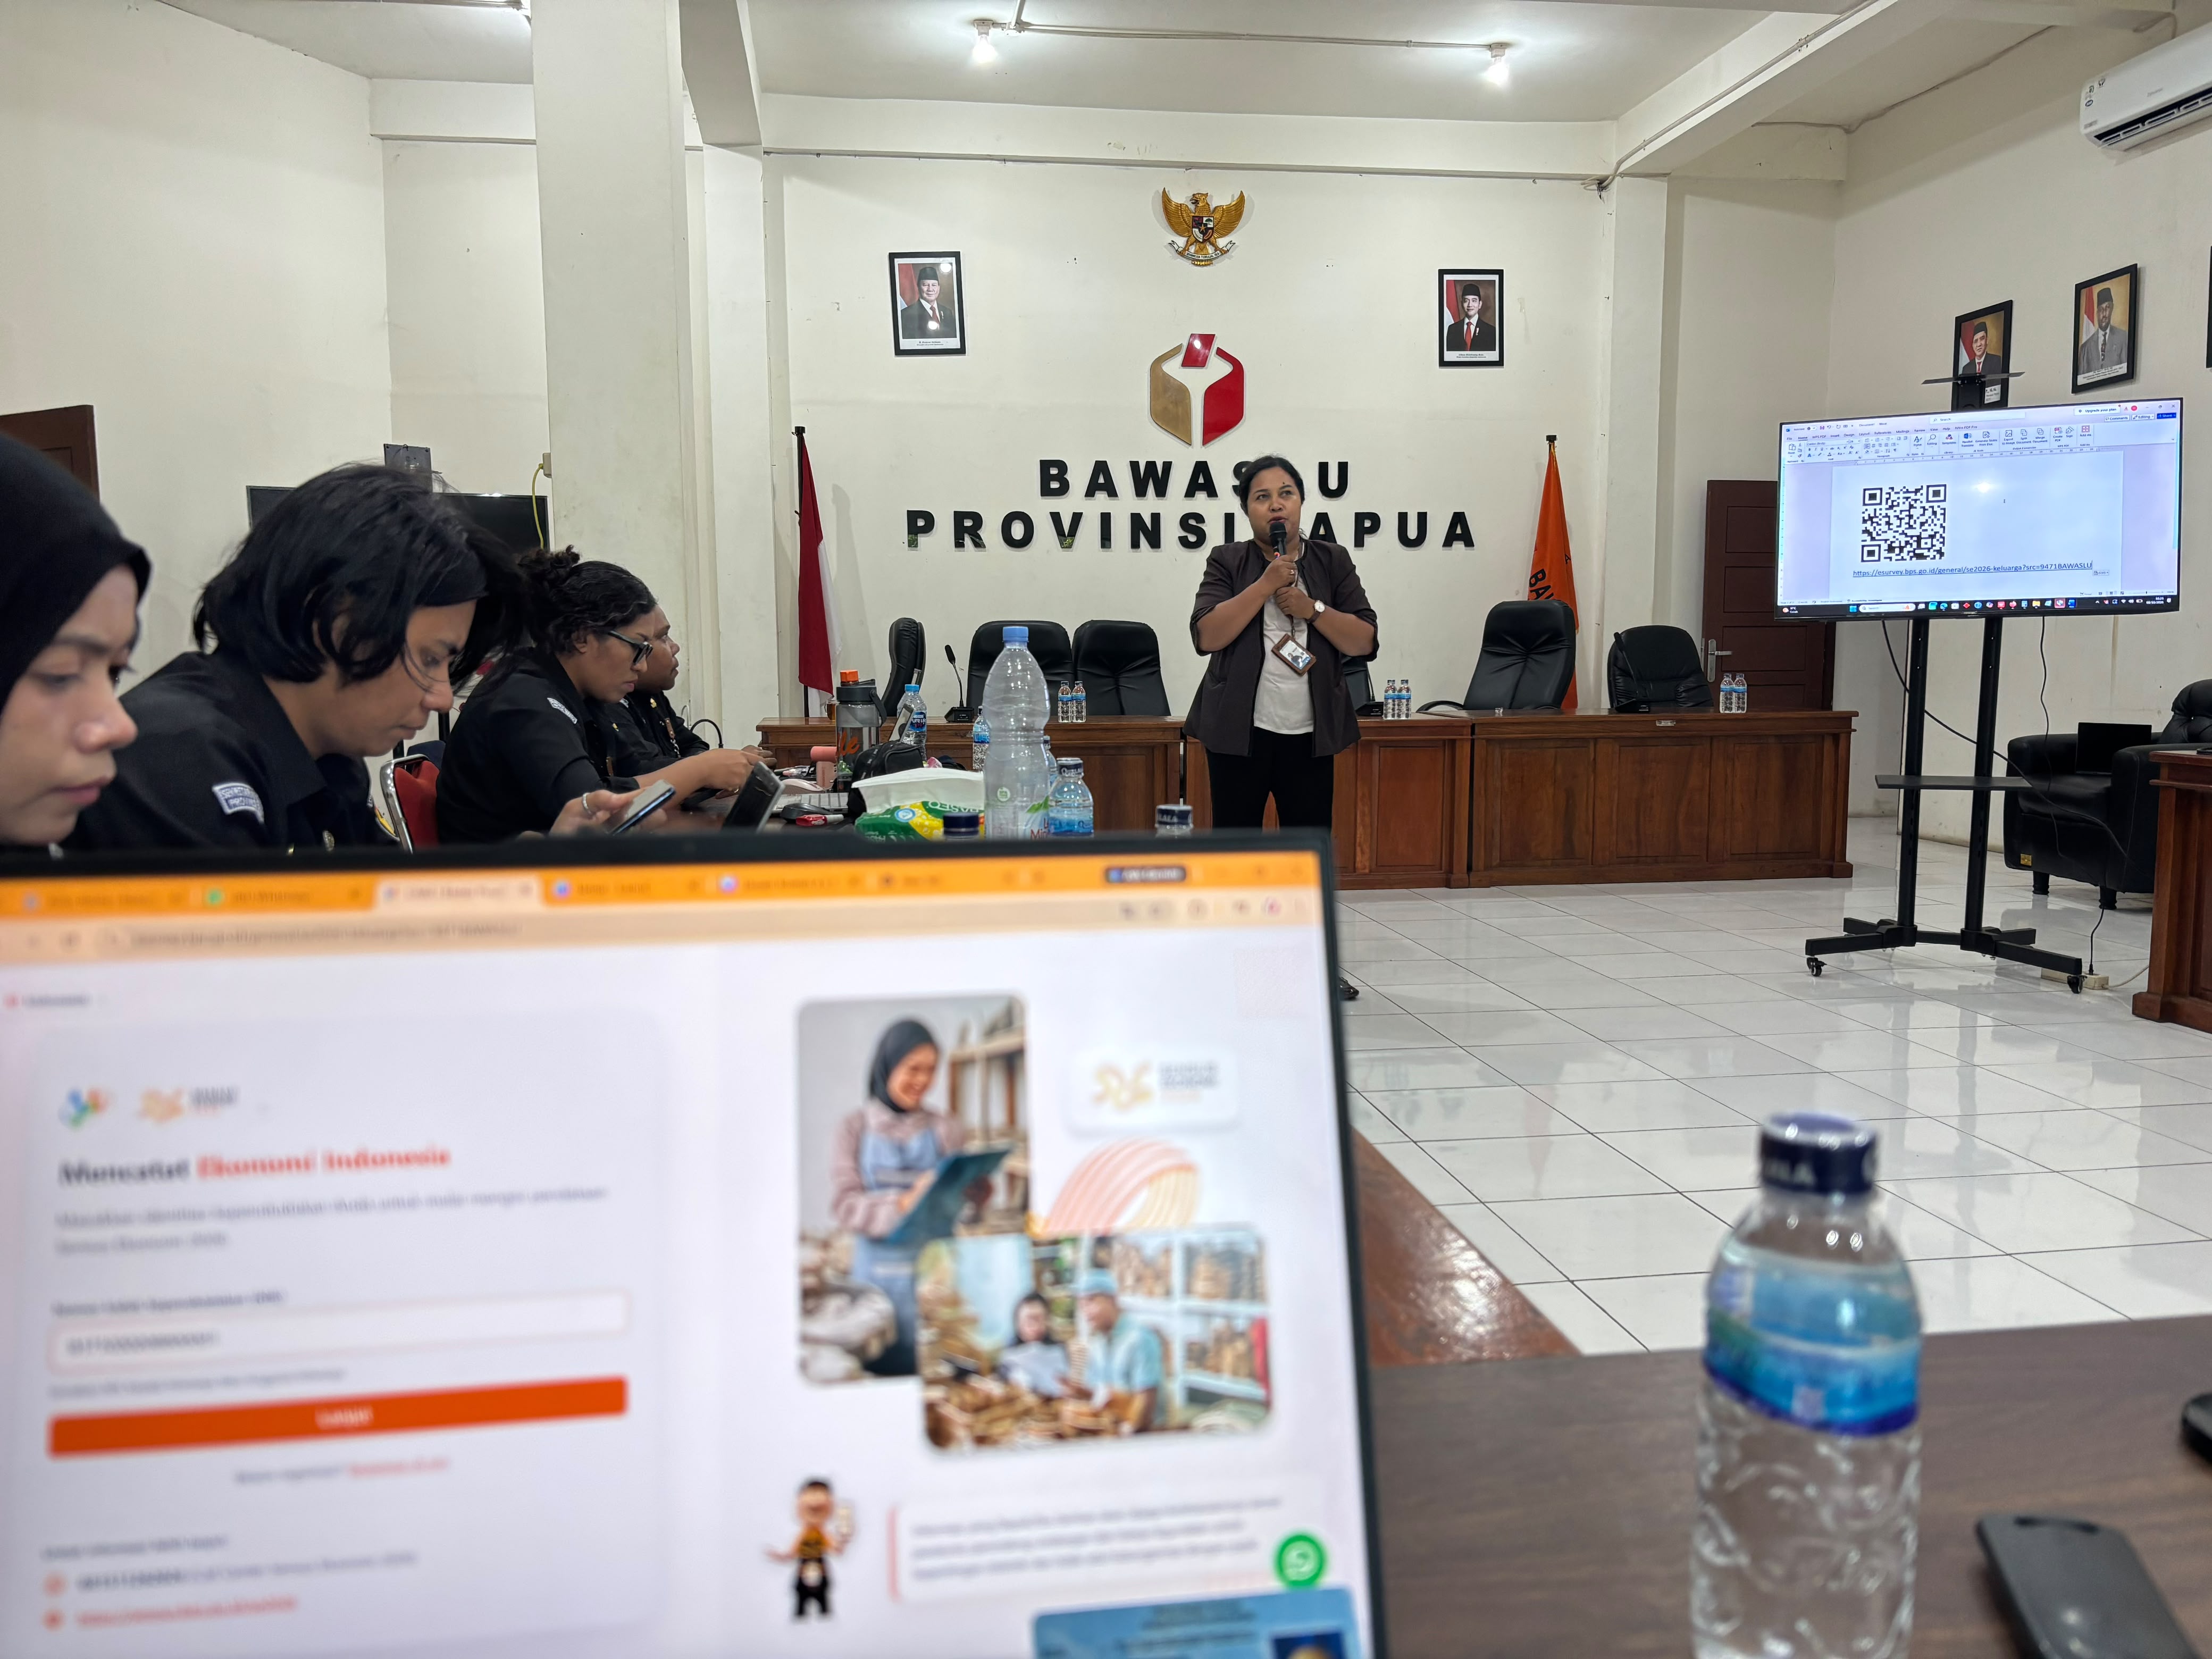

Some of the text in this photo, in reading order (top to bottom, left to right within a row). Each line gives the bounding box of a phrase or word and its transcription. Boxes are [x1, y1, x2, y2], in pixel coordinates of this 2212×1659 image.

[1039, 459, 1348, 499] BAWAU
[906, 509, 1474, 549] PROVINSI APUA
[1529, 568, 1554, 600] BA
[1853, 562, 2092, 577] https://esurvey.bps.go.id/general/se2026-keluarga?src=9471BAWASLU
